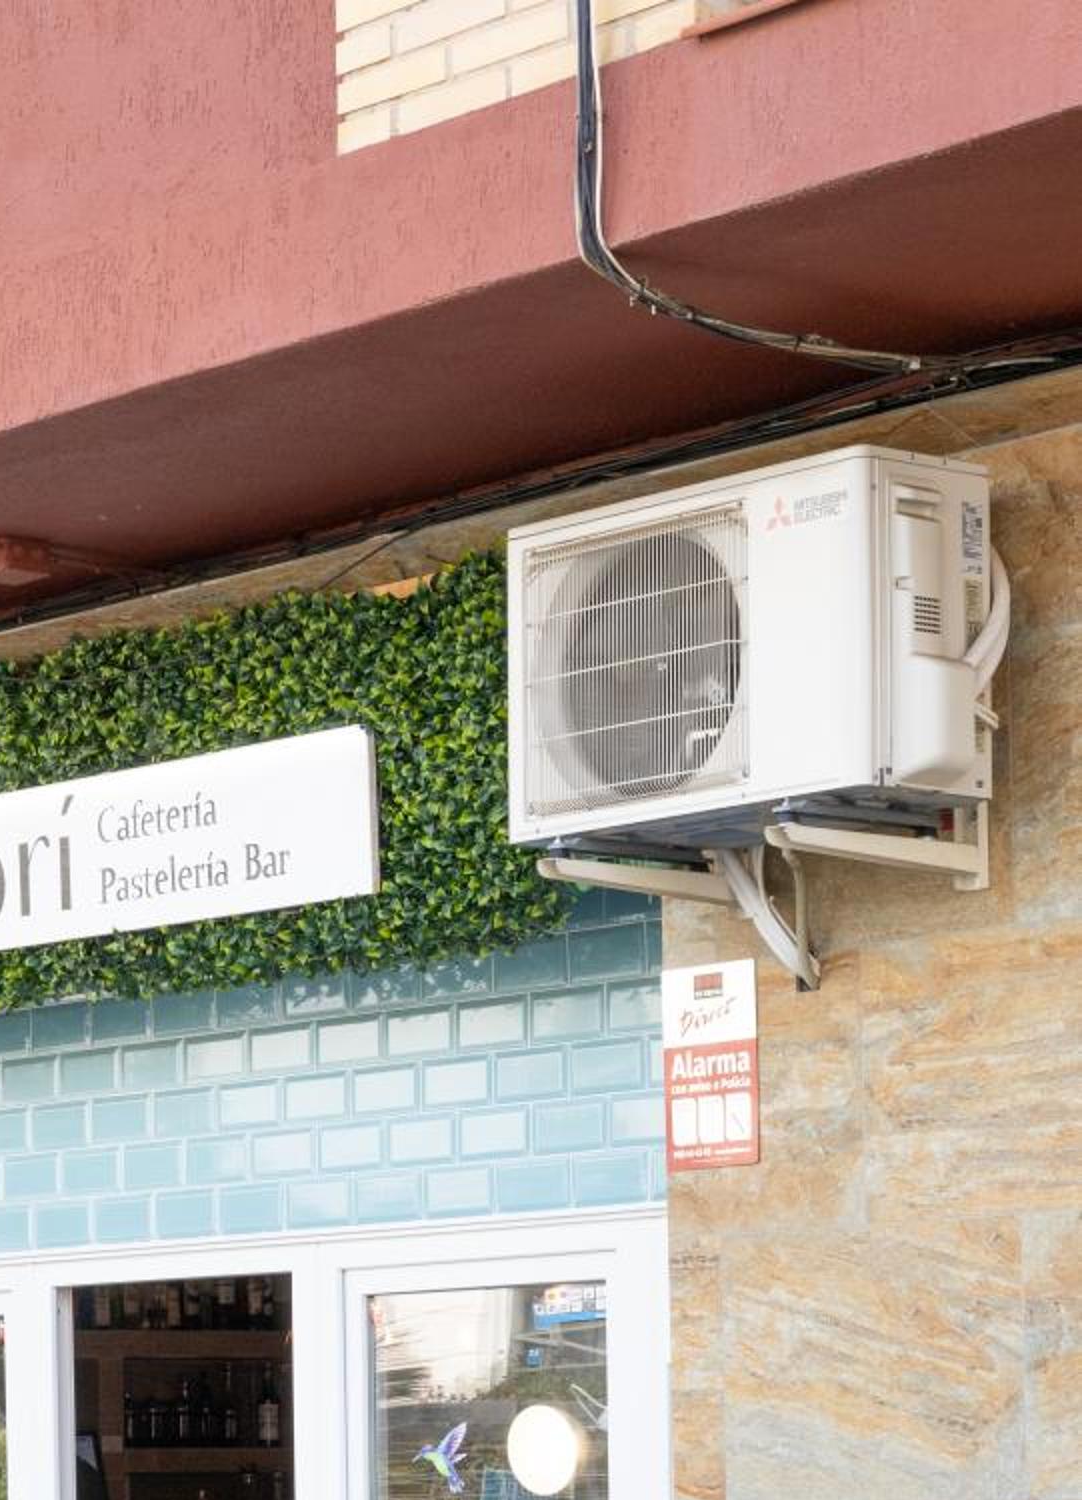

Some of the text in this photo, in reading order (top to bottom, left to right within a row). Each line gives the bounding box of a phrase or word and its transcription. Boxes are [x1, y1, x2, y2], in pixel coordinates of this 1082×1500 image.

[98, 792, 217, 843] Cafetería
[100, 843, 290, 904] Pastelería Bar
[672, 1051, 750, 1081] Alarma
